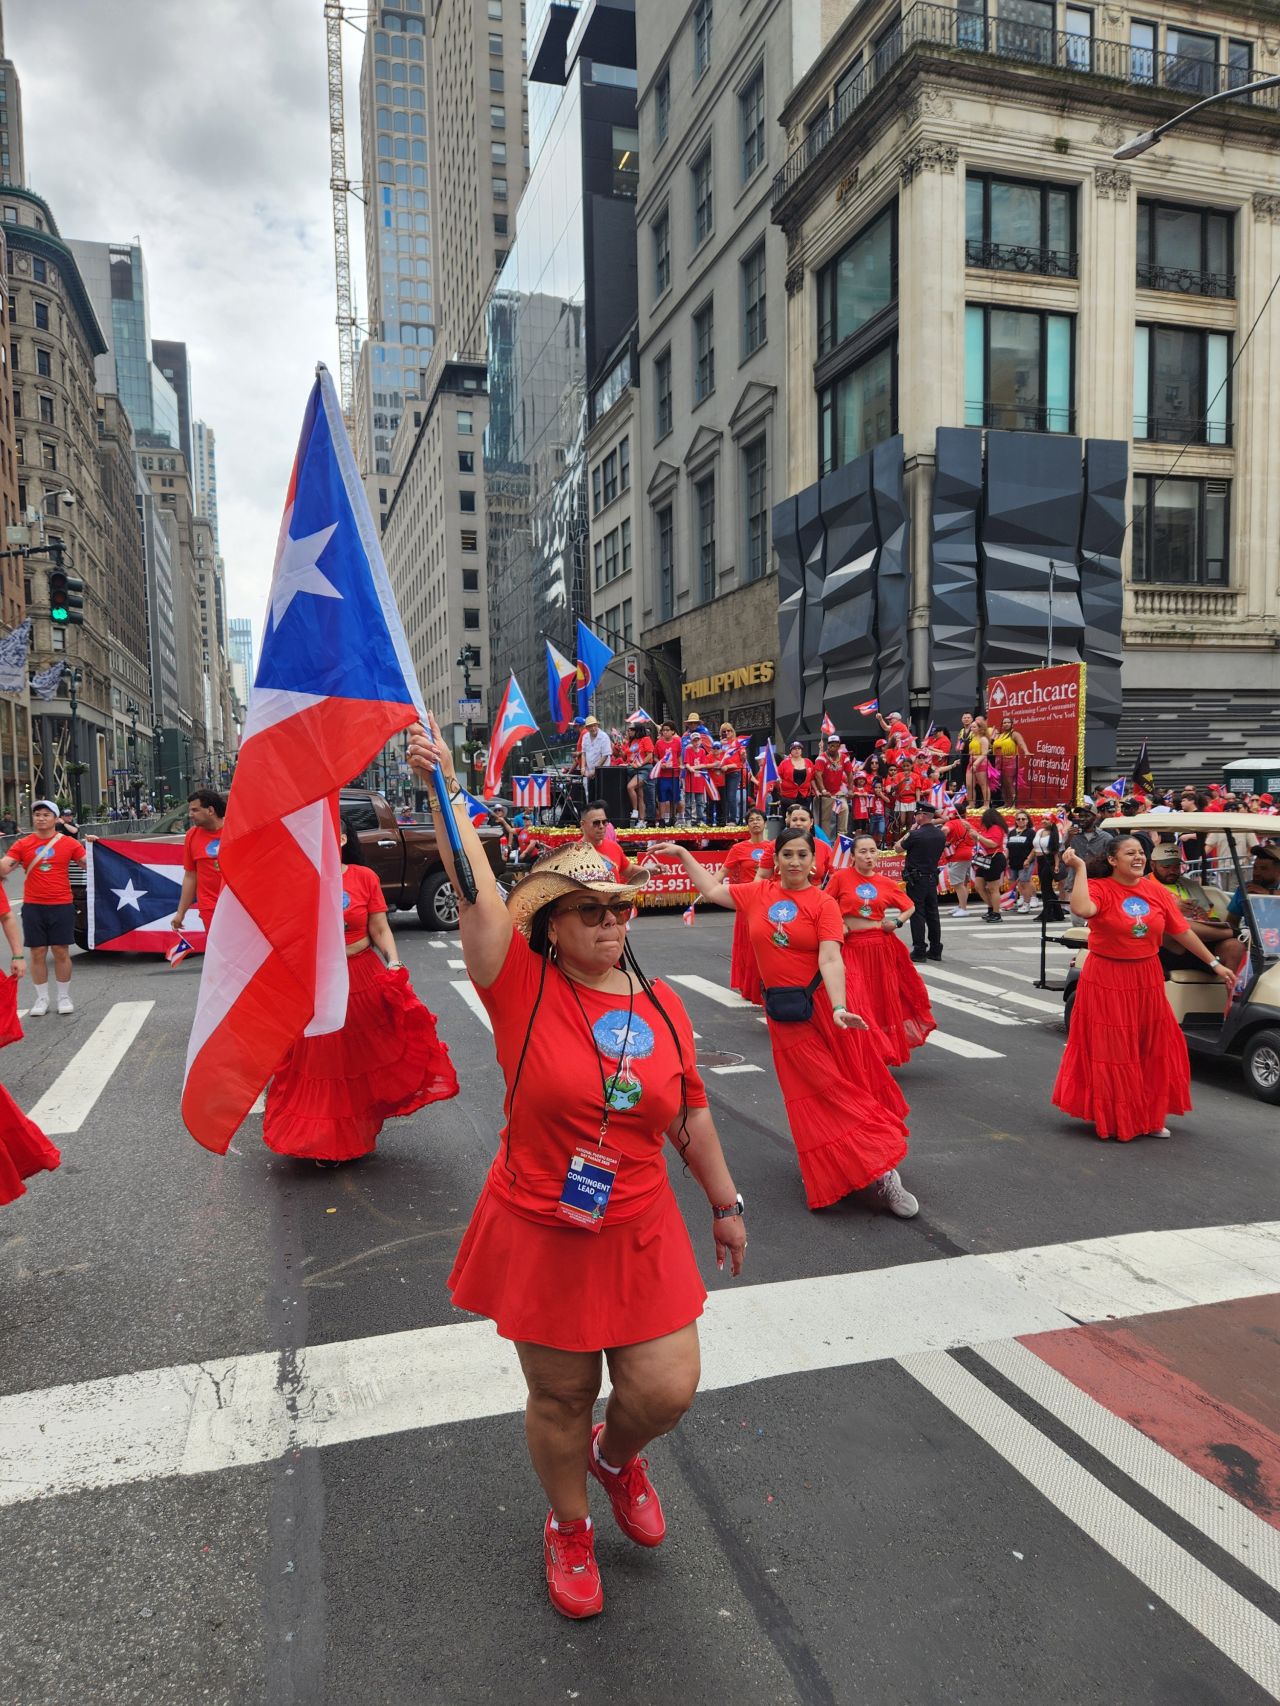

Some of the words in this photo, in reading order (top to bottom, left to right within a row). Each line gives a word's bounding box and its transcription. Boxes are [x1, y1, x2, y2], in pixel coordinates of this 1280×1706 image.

[682, 662, 774, 701] PHILIPPINES
[1009, 681, 1077, 706] archcare
[1048, 702, 1076, 711] Community
[1064, 710, 1075, 718] York
[1036, 740, 1065, 755] Estamos
[1028, 758, 1071, 771] contratando!
[1046, 772, 1068, 790] hiring!
[568, 1172, 610, 1192] CONTINGENT
[578, 1184, 595, 1195] LEAD
